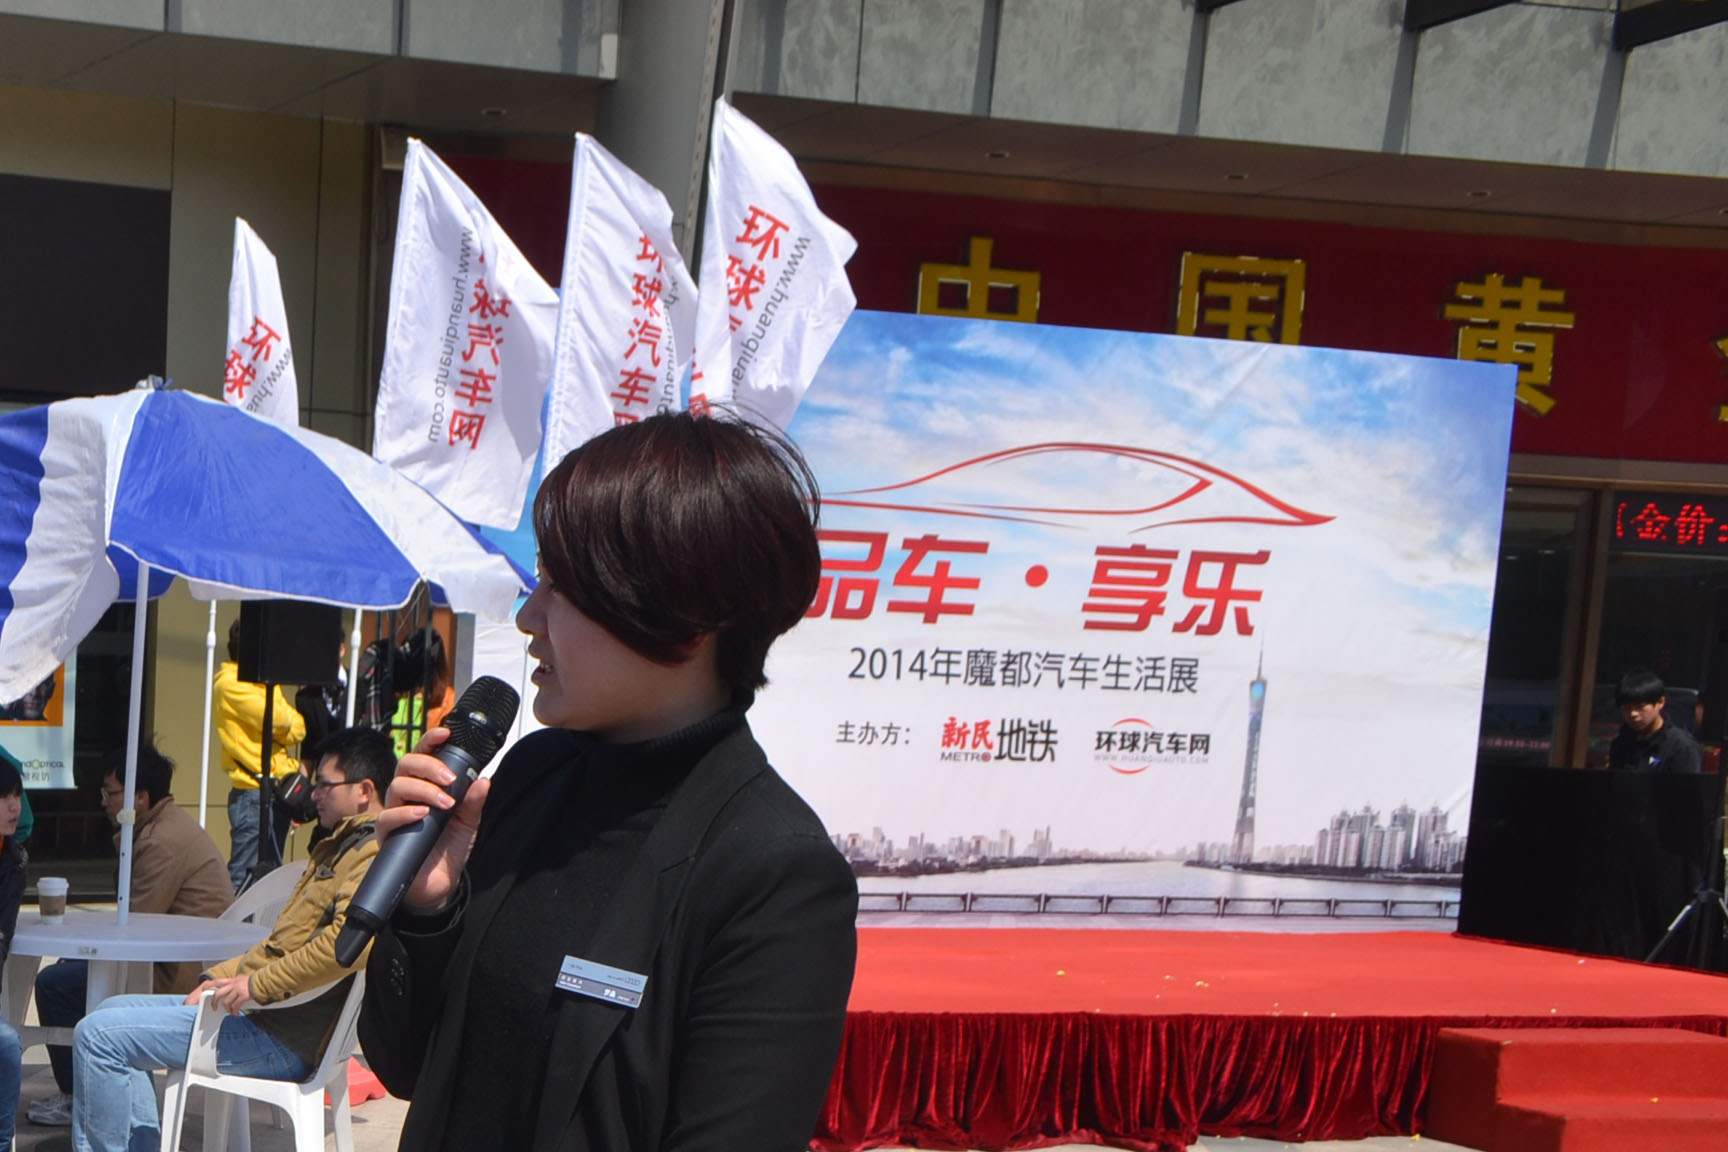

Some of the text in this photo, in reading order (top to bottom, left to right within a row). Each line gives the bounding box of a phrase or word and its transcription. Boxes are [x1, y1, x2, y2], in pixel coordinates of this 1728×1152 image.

[916, 236, 1728, 422] 中国黄
[848, 645, 1200, 695] 2014年魔都汽车生活展
[1094, 729, 1212, 755] 环球汽车网
